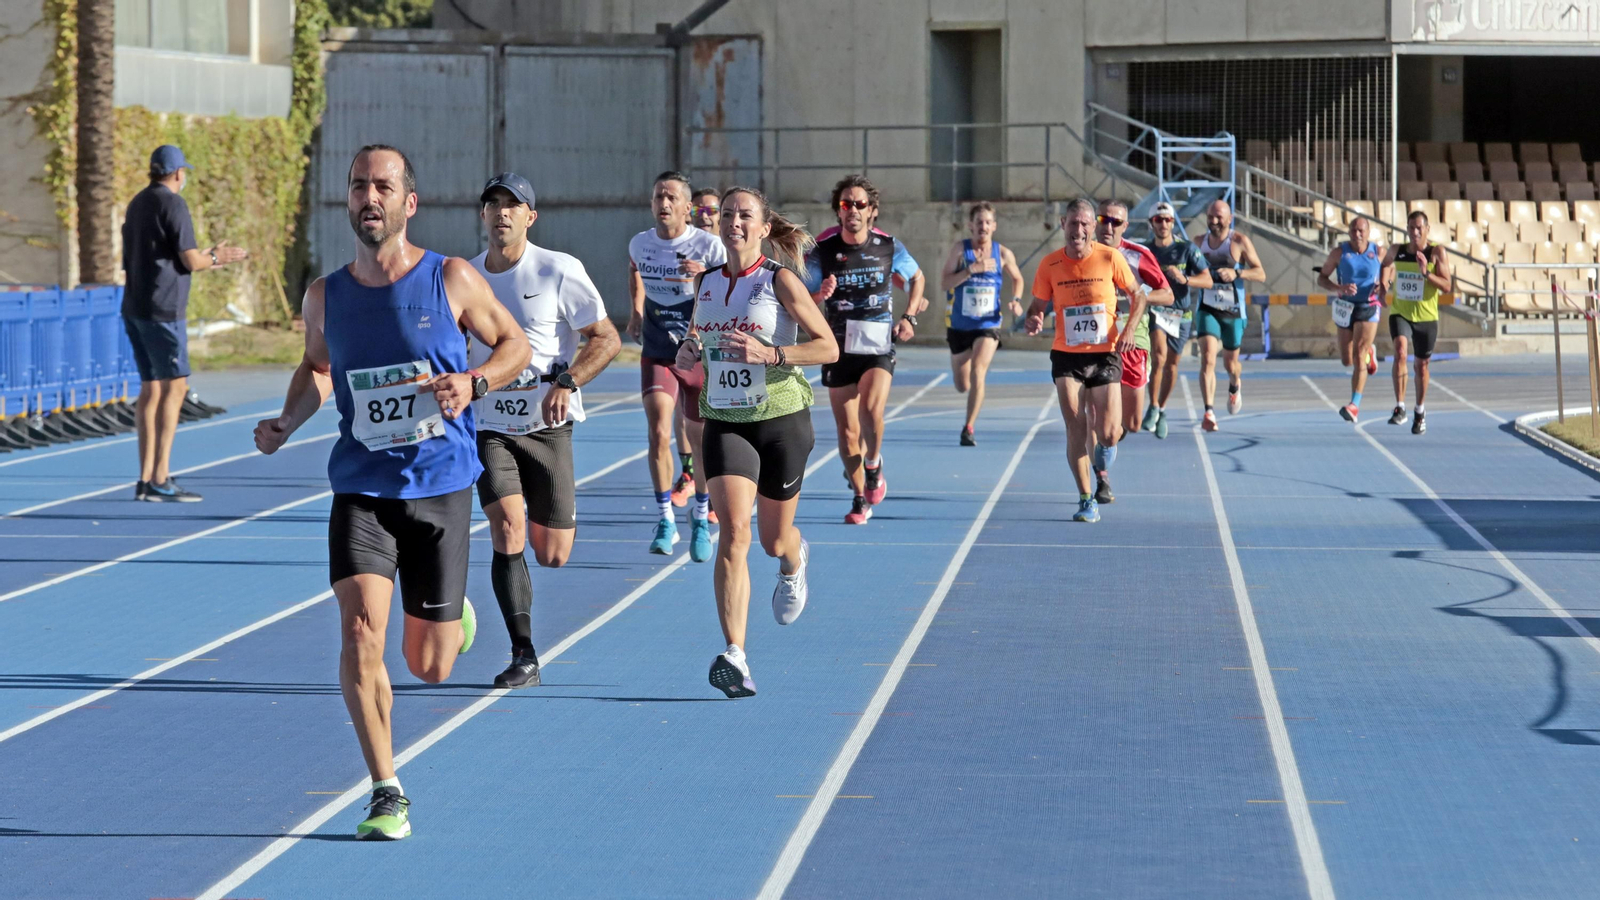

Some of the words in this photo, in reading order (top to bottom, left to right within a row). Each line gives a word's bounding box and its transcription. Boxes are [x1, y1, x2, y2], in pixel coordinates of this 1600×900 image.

[1401, 283, 1418, 292] 595
[971, 297, 988, 307] 319
[1073, 319, 1098, 333] 479
[719, 369, 752, 389] 403
[367, 394, 417, 424] 827
[494, 398, 529, 416] 462
